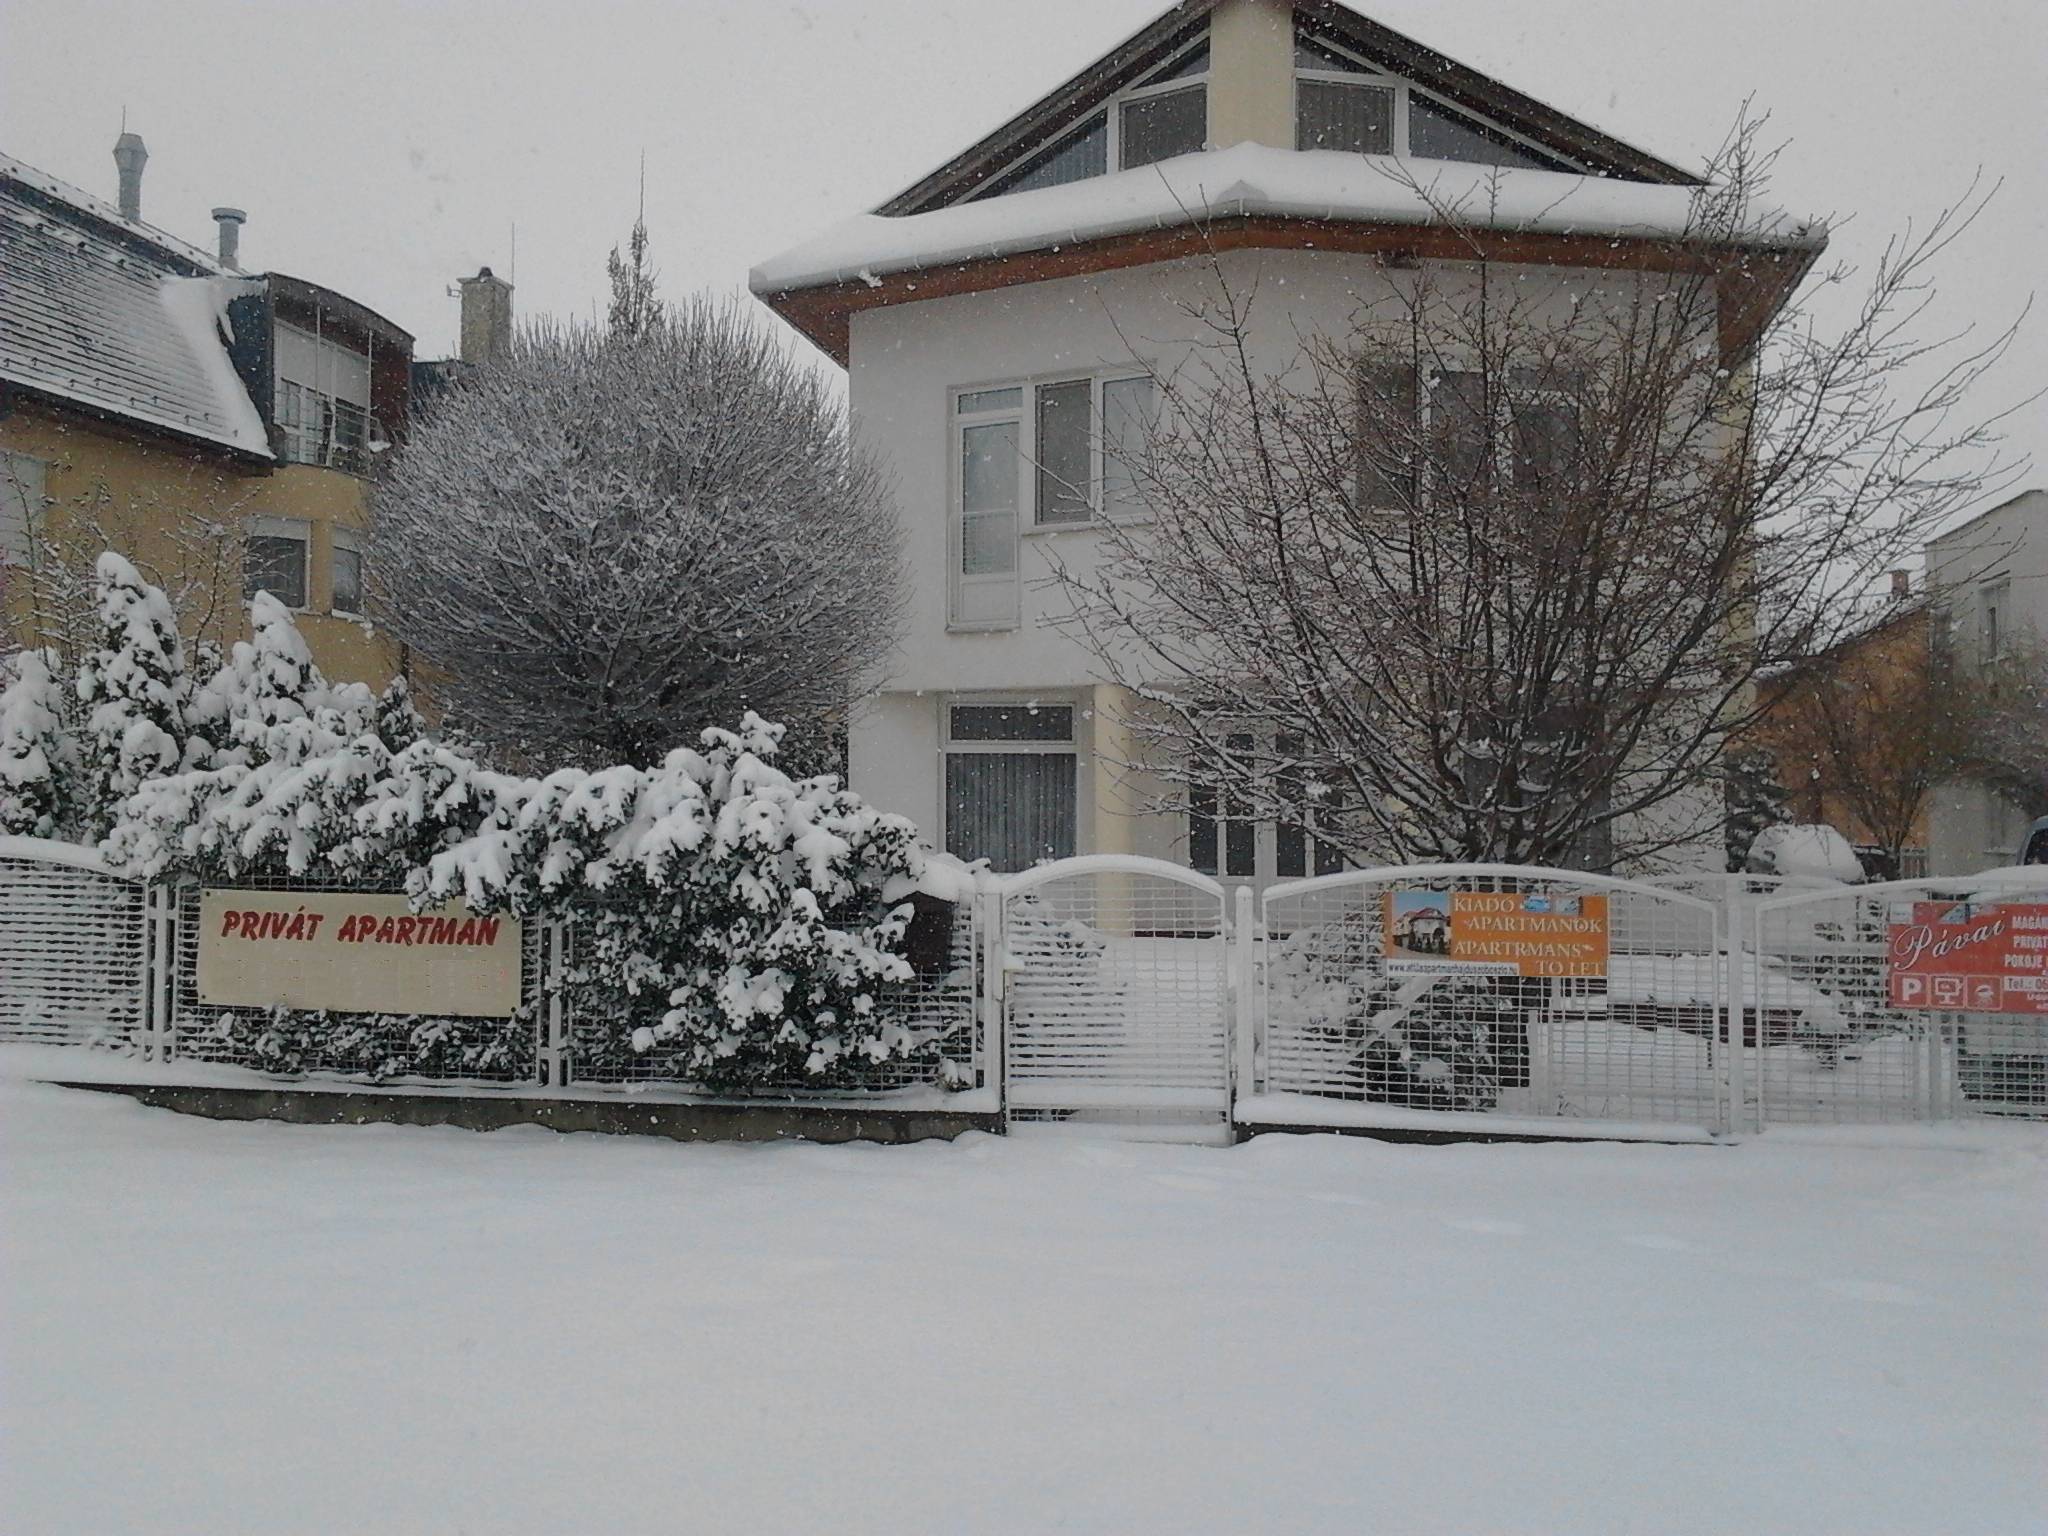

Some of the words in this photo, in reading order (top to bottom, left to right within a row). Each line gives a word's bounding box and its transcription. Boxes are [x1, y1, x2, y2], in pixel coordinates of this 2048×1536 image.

[1454, 895, 1515, 913] KIADÓ
[221, 905, 324, 941] PRIVÁT
[337, 913, 501, 947] APARTMAN
[1467, 916, 1603, 933] APARTMANOK
[1894, 910, 2006, 971] Pávai
[1535, 959, 1563, 976] TO
[1569, 960, 1603, 976] LET
